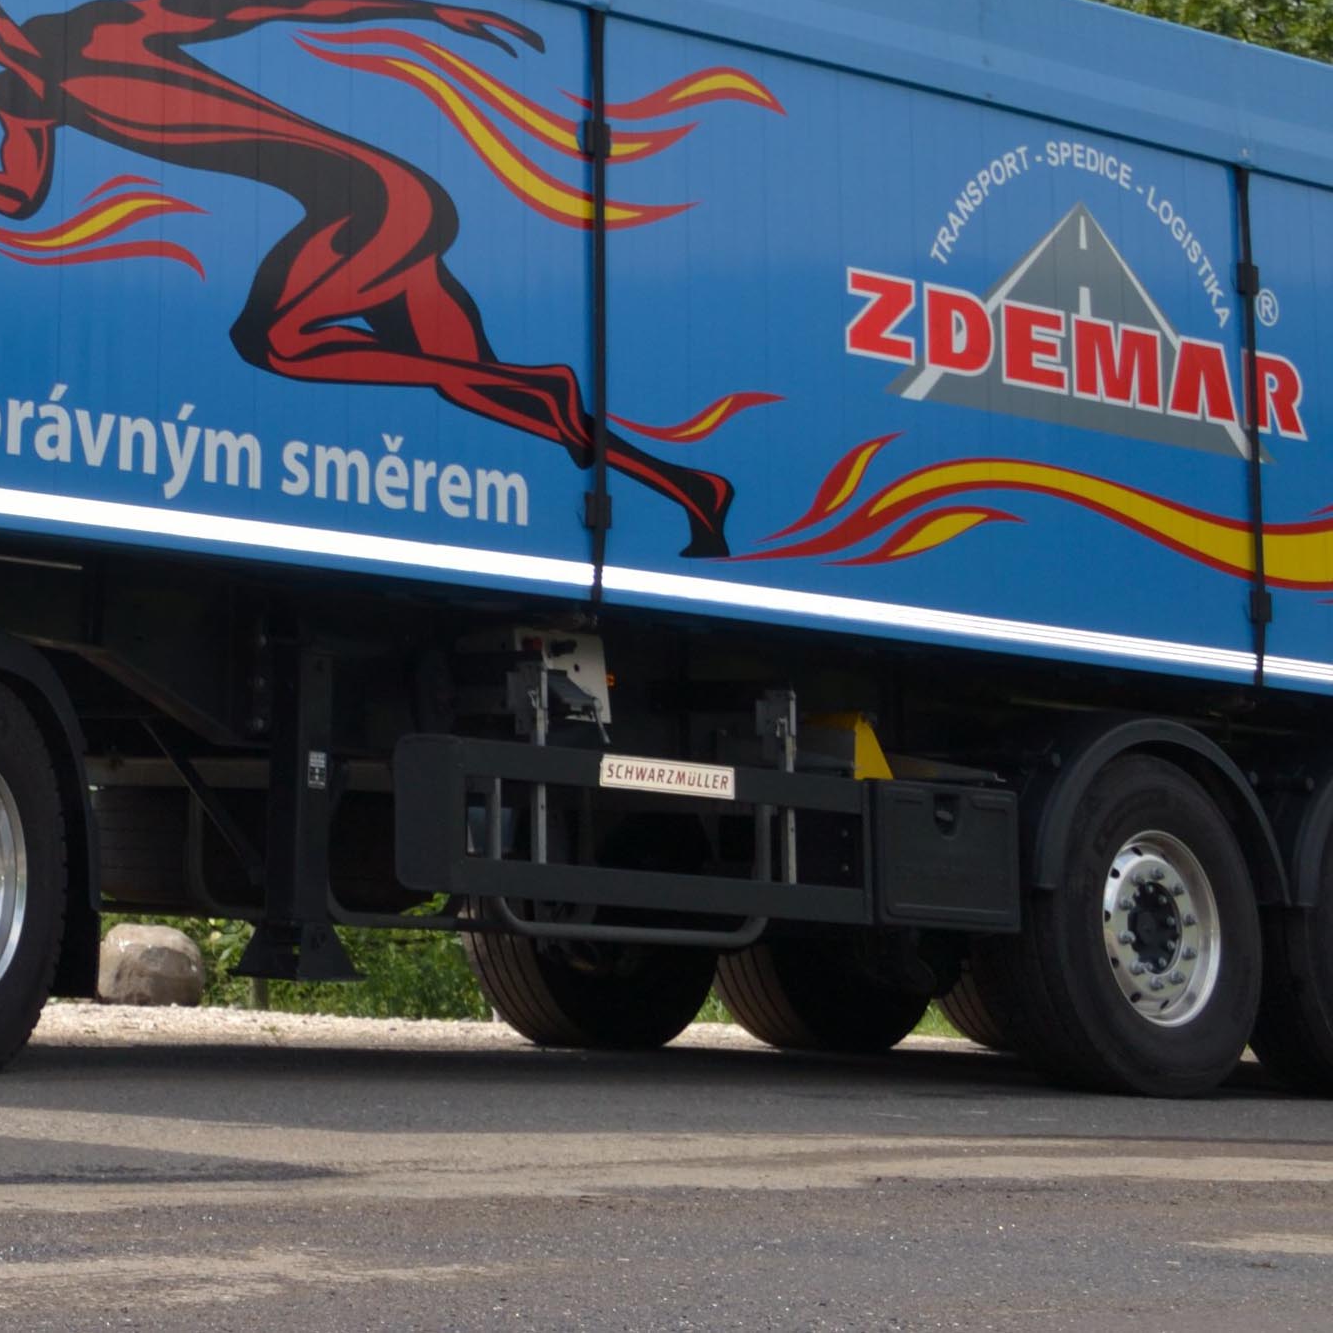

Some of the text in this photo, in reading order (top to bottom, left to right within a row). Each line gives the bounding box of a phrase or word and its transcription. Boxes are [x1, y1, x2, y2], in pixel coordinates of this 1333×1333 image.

[930, 141, 1231, 329] TRANSPORT SPEDICE LOGISTIKA
[846, 266, 1309, 442] ZDEMAR
[281, 433, 529, 527] směrem
